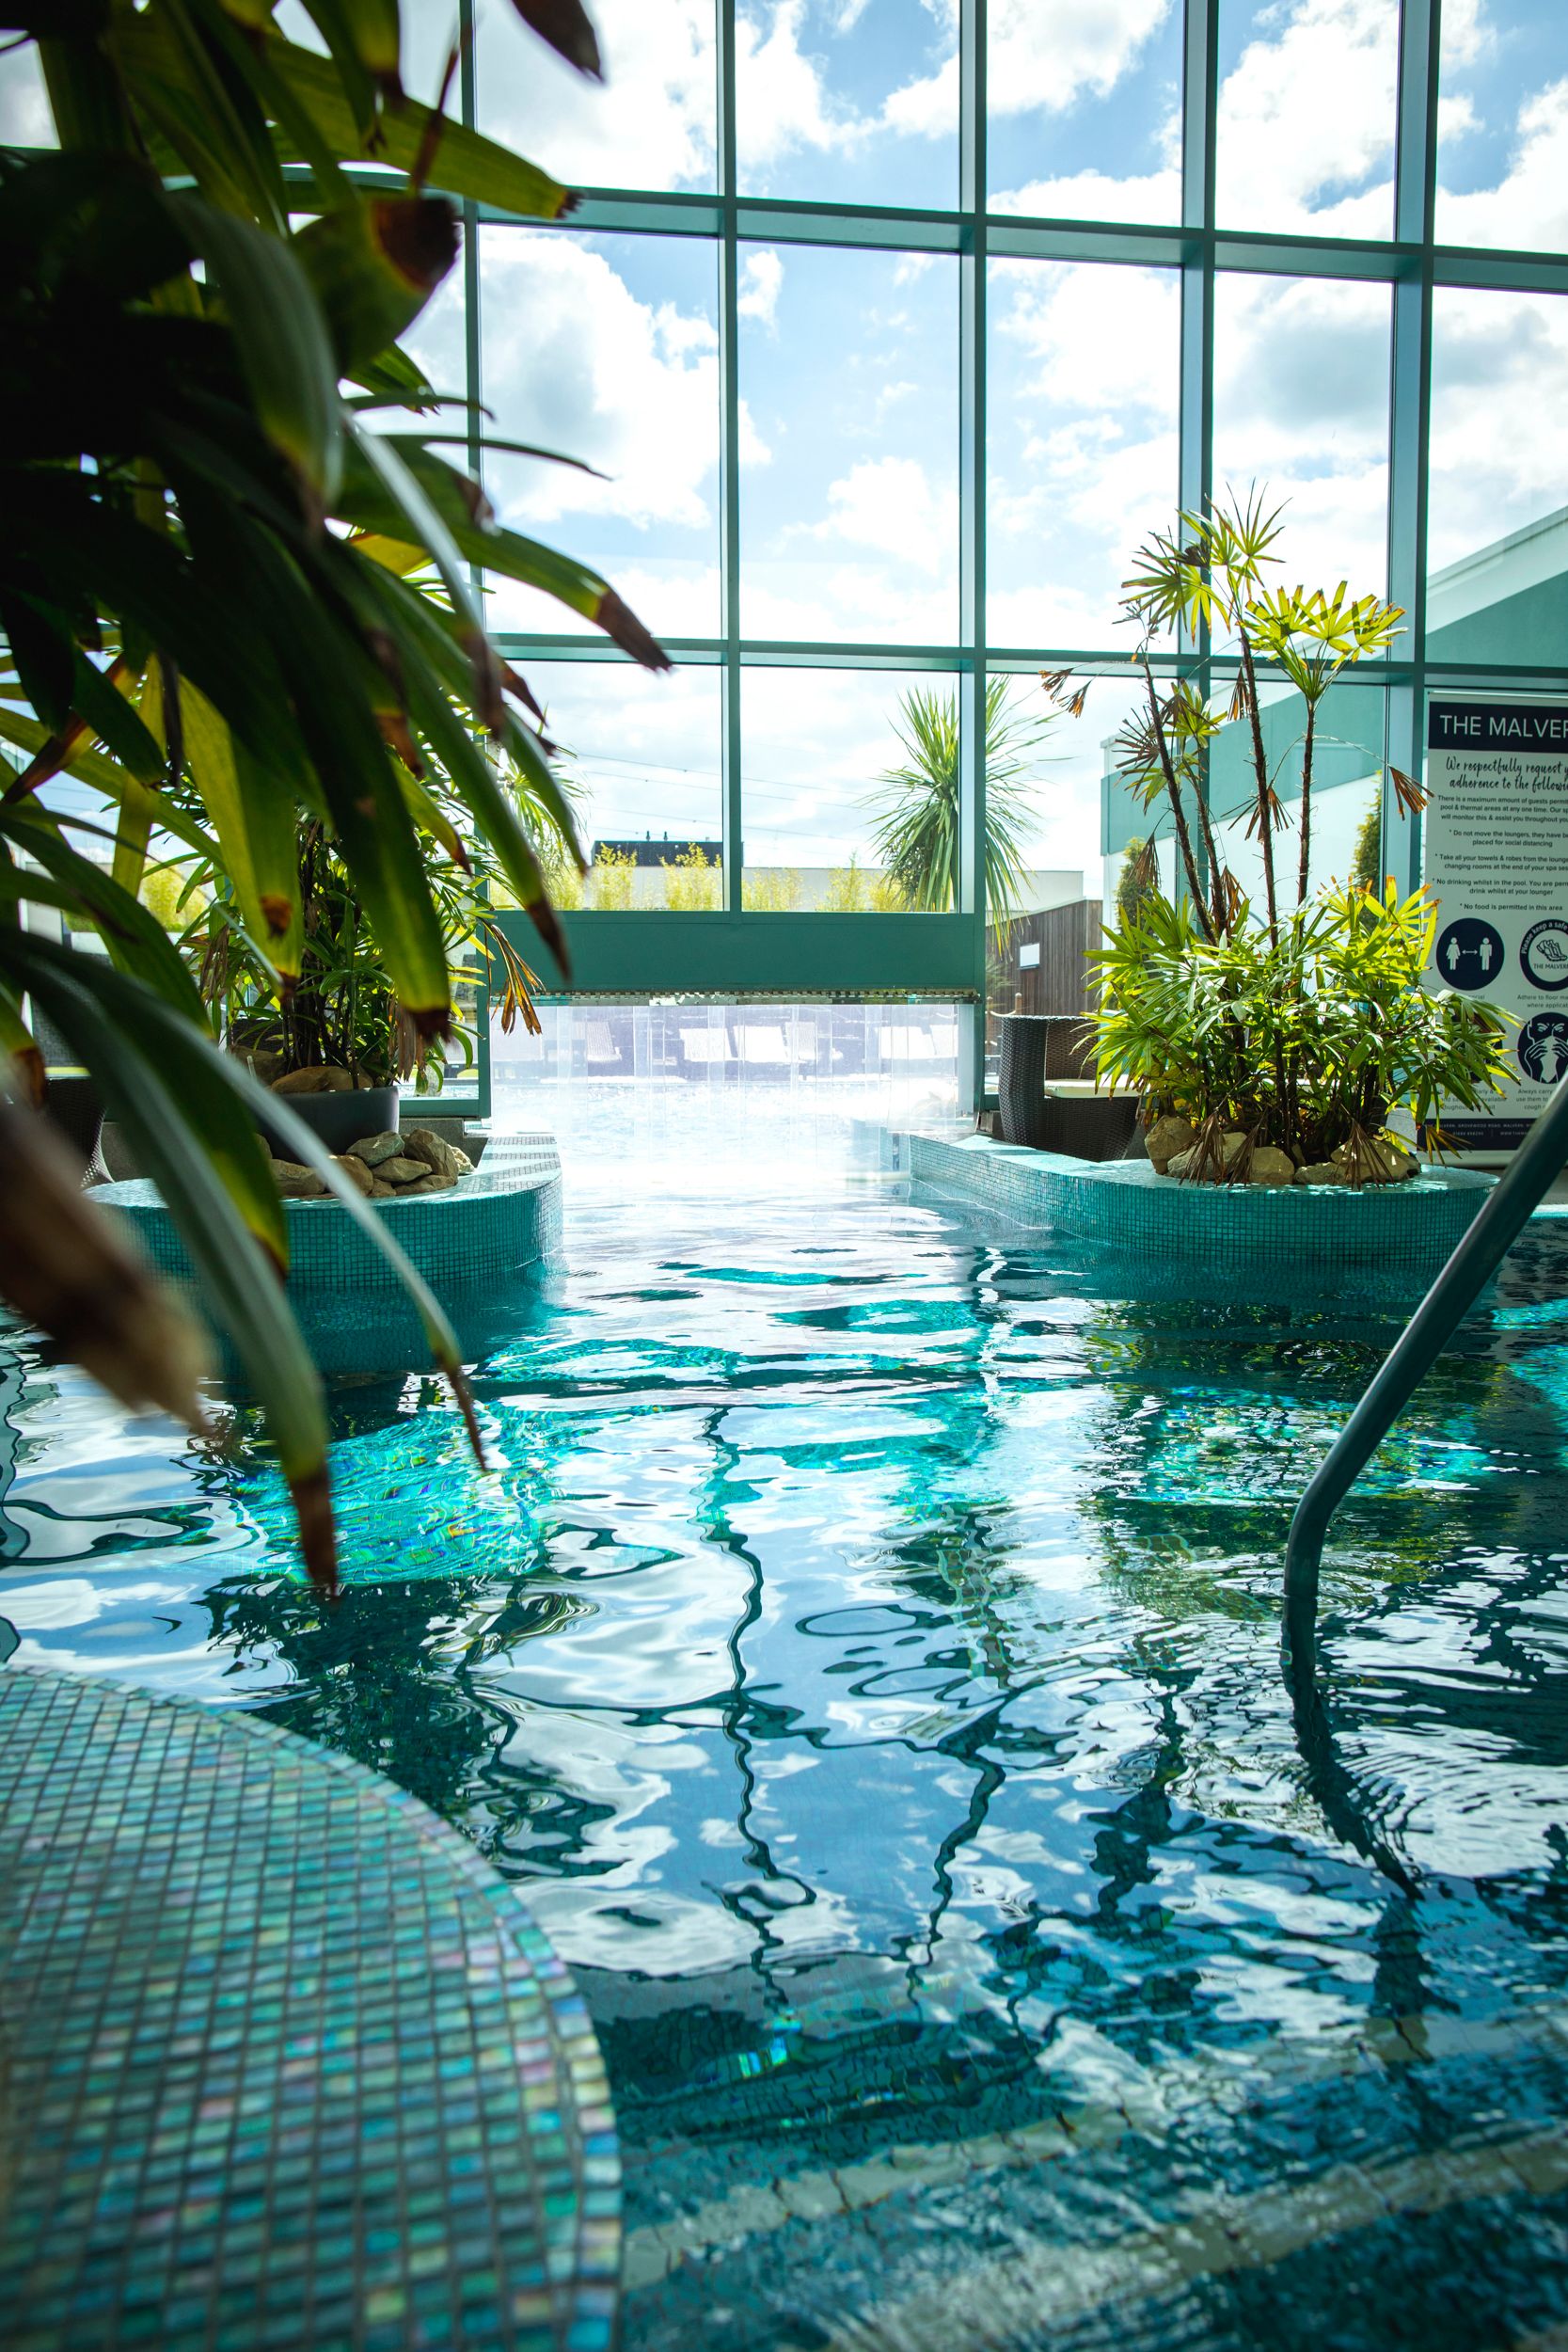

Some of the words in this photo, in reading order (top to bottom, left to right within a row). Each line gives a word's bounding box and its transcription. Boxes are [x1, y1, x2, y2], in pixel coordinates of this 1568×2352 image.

[1439, 714, 1481, 736] THE
[1446, 755, 1461, 771] We
[1464, 757, 1522, 778] respectfully
[1526, 761, 1562, 778] request
[1449, 773, 1499, 788] adherence
[1502, 776, 1511, 789] to
[1514, 775, 1528, 789] the
[1521, 933, 1533, 954] Please
[1531, 923, 1547, 934] keep
[1554, 922, 1568, 930] safe
